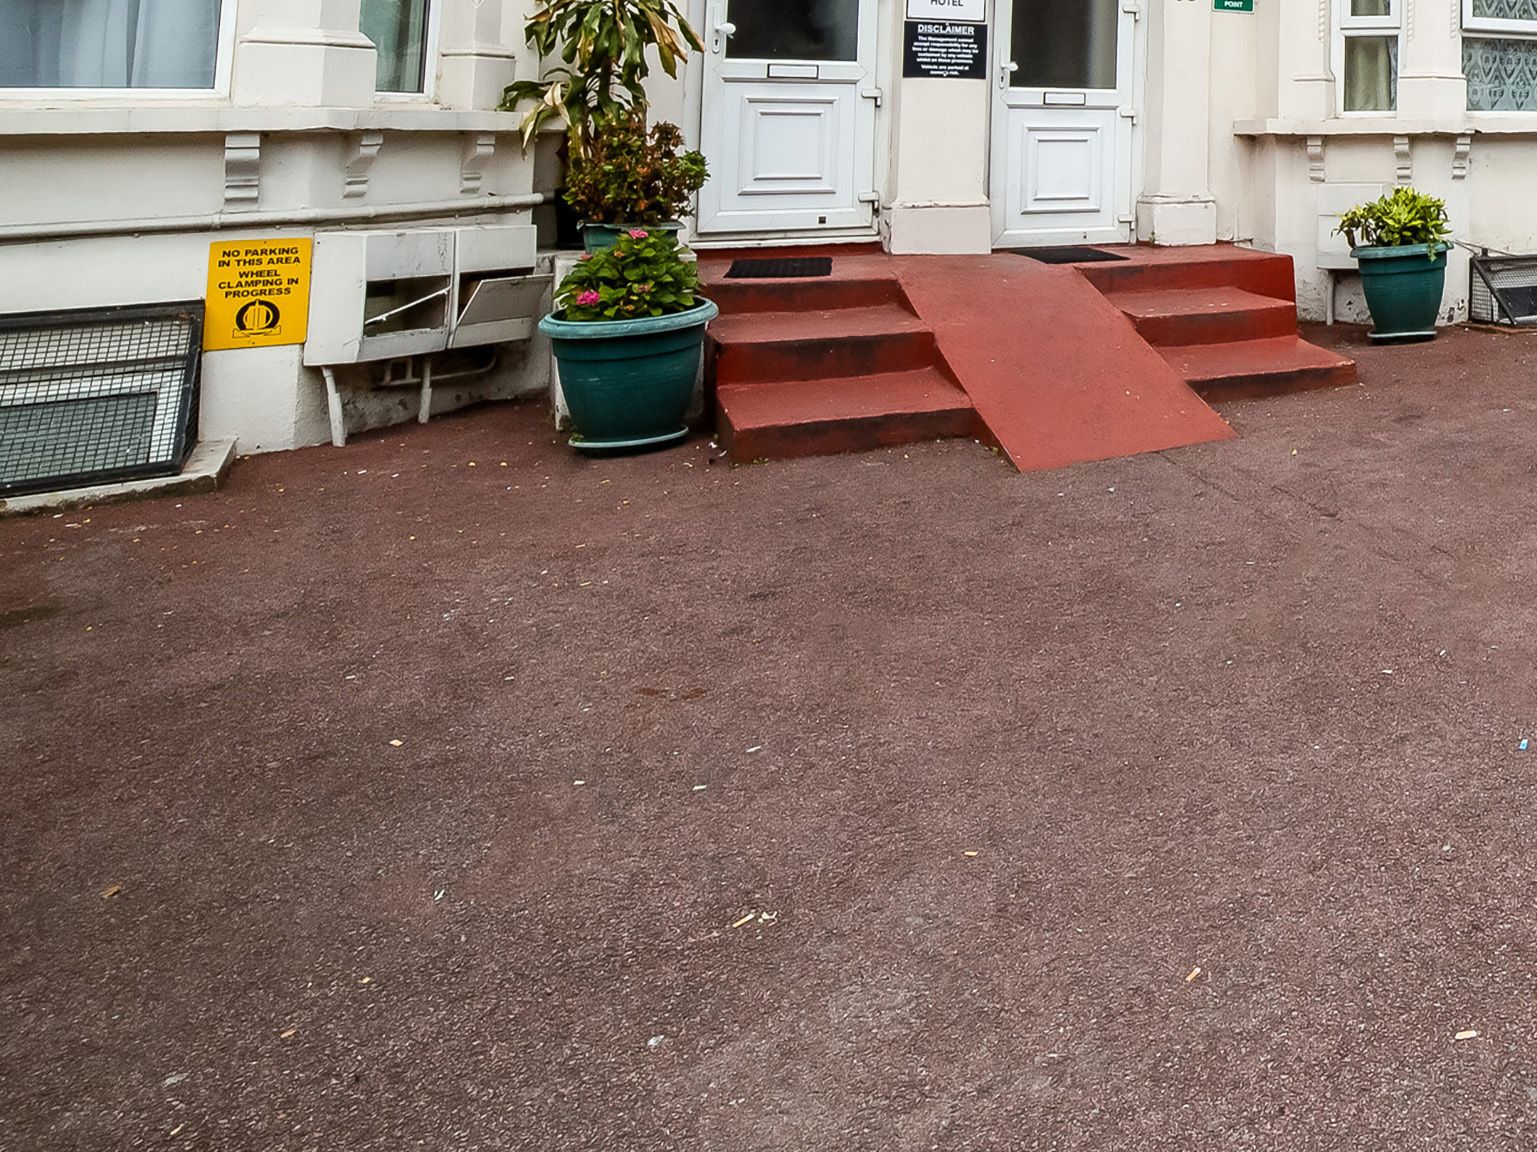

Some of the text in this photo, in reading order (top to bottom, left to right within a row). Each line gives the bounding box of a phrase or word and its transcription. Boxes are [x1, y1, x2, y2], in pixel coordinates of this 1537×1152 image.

[918, 24, 975, 35] DISCLAIMER
[222, 247, 298, 258] NO PARKING
[235, 258, 263, 266] THIS
[267, 256, 300, 265] AREA
[239, 270, 281, 278] WHEEL
[218, 279, 282, 289] CLAMPING
[225, 287, 291, 298] PROGRESS
